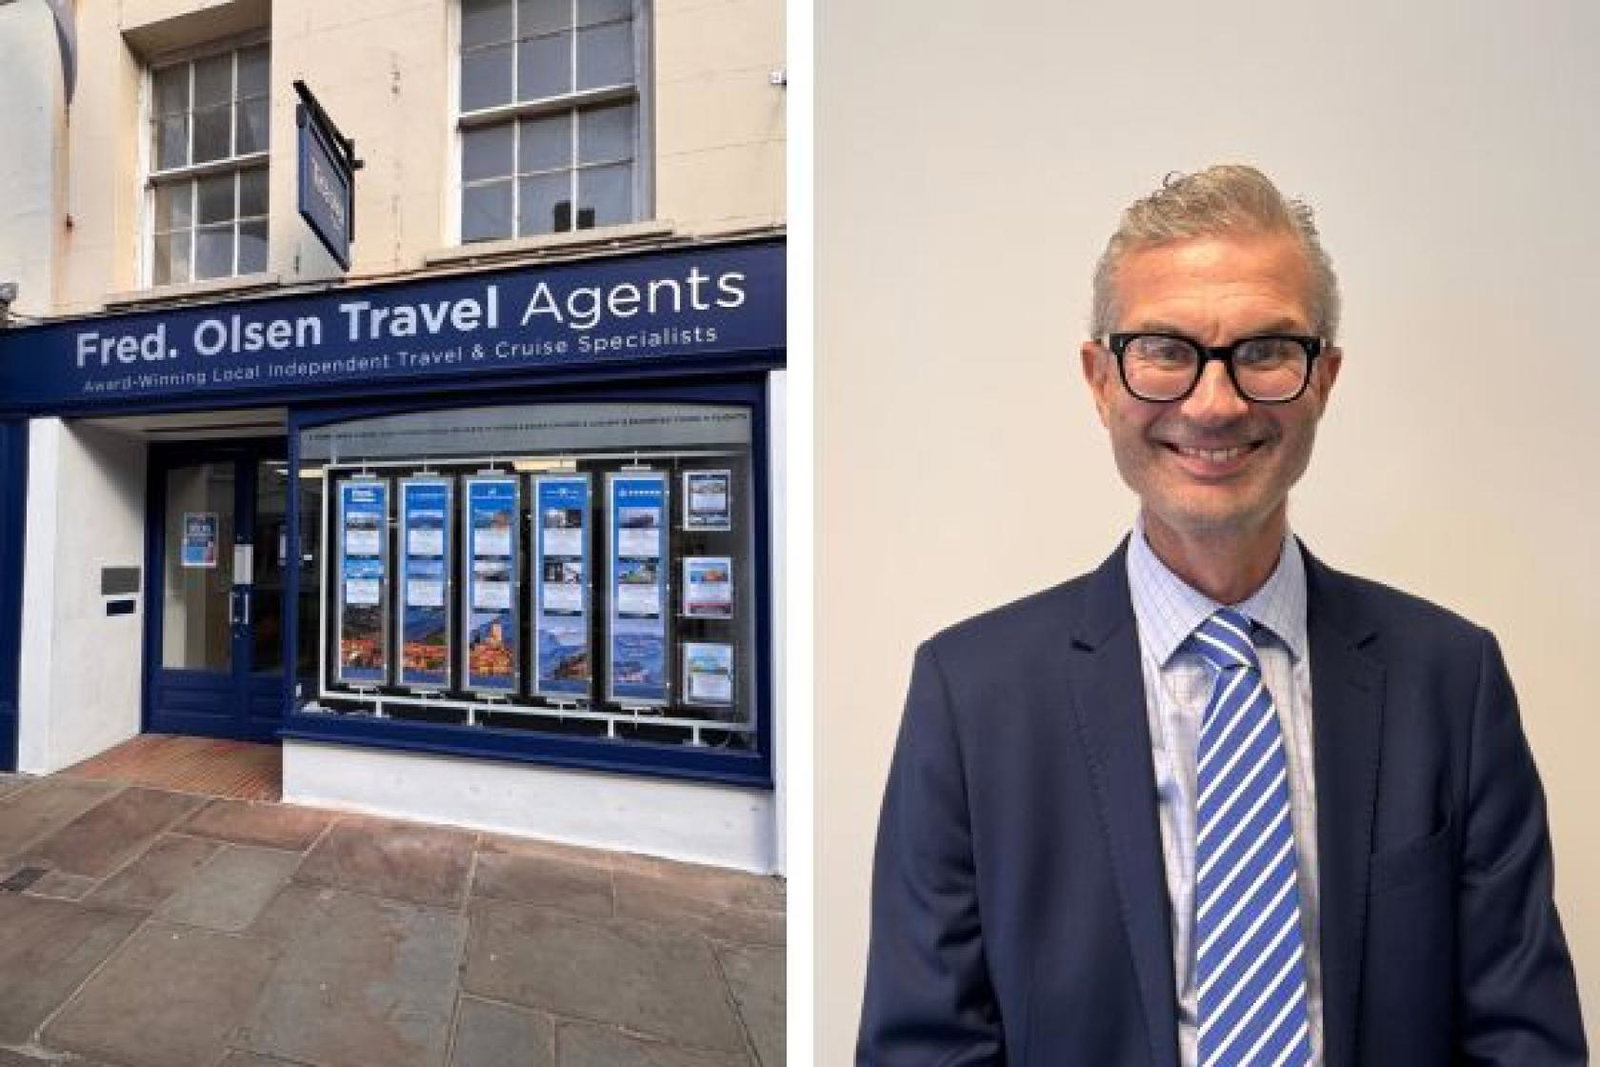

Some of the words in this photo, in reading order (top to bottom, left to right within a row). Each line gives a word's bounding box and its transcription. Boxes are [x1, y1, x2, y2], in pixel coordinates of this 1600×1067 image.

[76, 323, 178, 368] Fred.
[193, 314, 321, 356] Olsen
[340, 285, 498, 341] Travel
[520, 267, 746, 329] Agents
[83, 372, 207, 393] Award-Winning
[212, 364, 260, 382] Local
[269, 354, 389, 376] Independent
[397, 346, 463, 366] Travel
[471, 343, 484, 361] &
[495, 341, 568, 358] Cruise
[578, 326, 718, 353] Specialists
